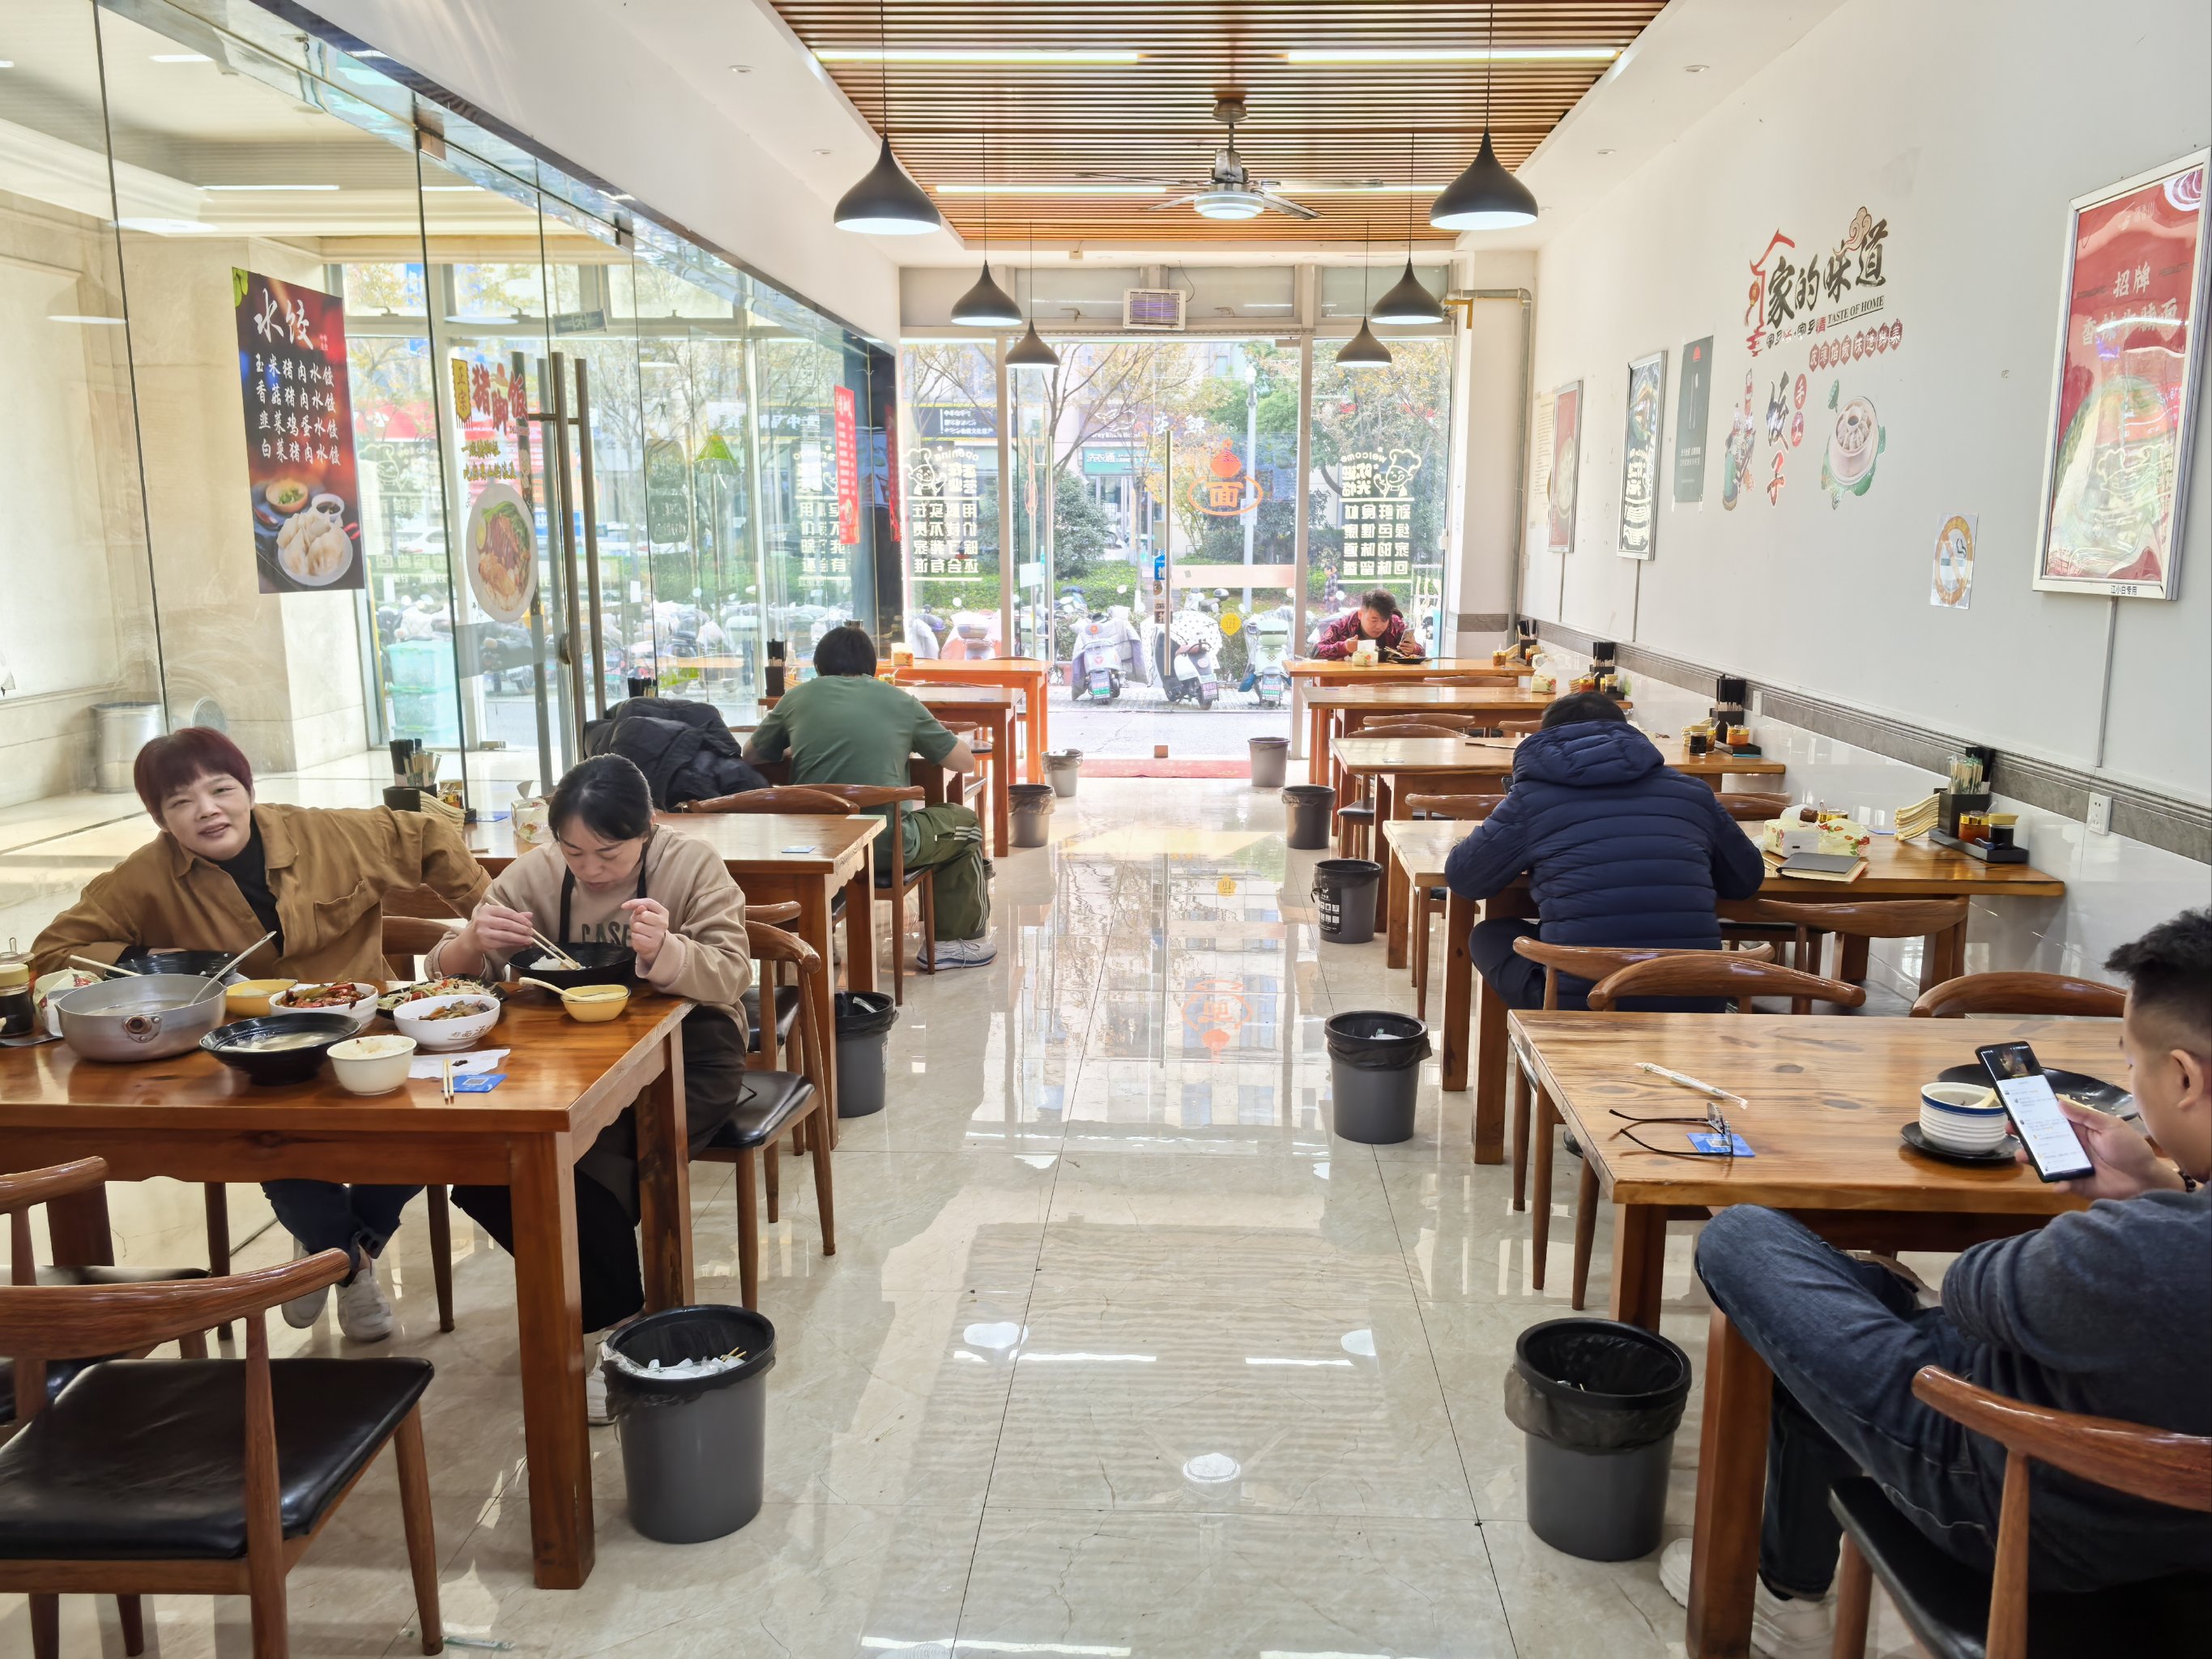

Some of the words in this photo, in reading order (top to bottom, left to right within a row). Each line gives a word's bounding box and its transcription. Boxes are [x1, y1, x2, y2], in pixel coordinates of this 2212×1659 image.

[1767, 219, 1888, 329] 家的味道
[2113, 262, 2150, 298] 招牌
[254, 288, 314, 350] 水饺
[1827, 309, 1848, 324] TASTE
[1850, 304, 1860, 315] OF
[1860, 295, 1885, 313] HOME
[255, 352, 335, 388] 玉米猪肉水饺
[256, 379, 336, 415] 香菇猪肉水饺
[457, 365, 467, 412] 正宗
[472, 361, 528, 436] 猪脚饭
[258, 409, 339, 440] 韭菜鸡蛋水饺
[262, 437, 341, 467] 白菜猪肉水饺
[1205, 482, 1244, 508] 面
[2111, 585, 2137, 595] 江小白专用
